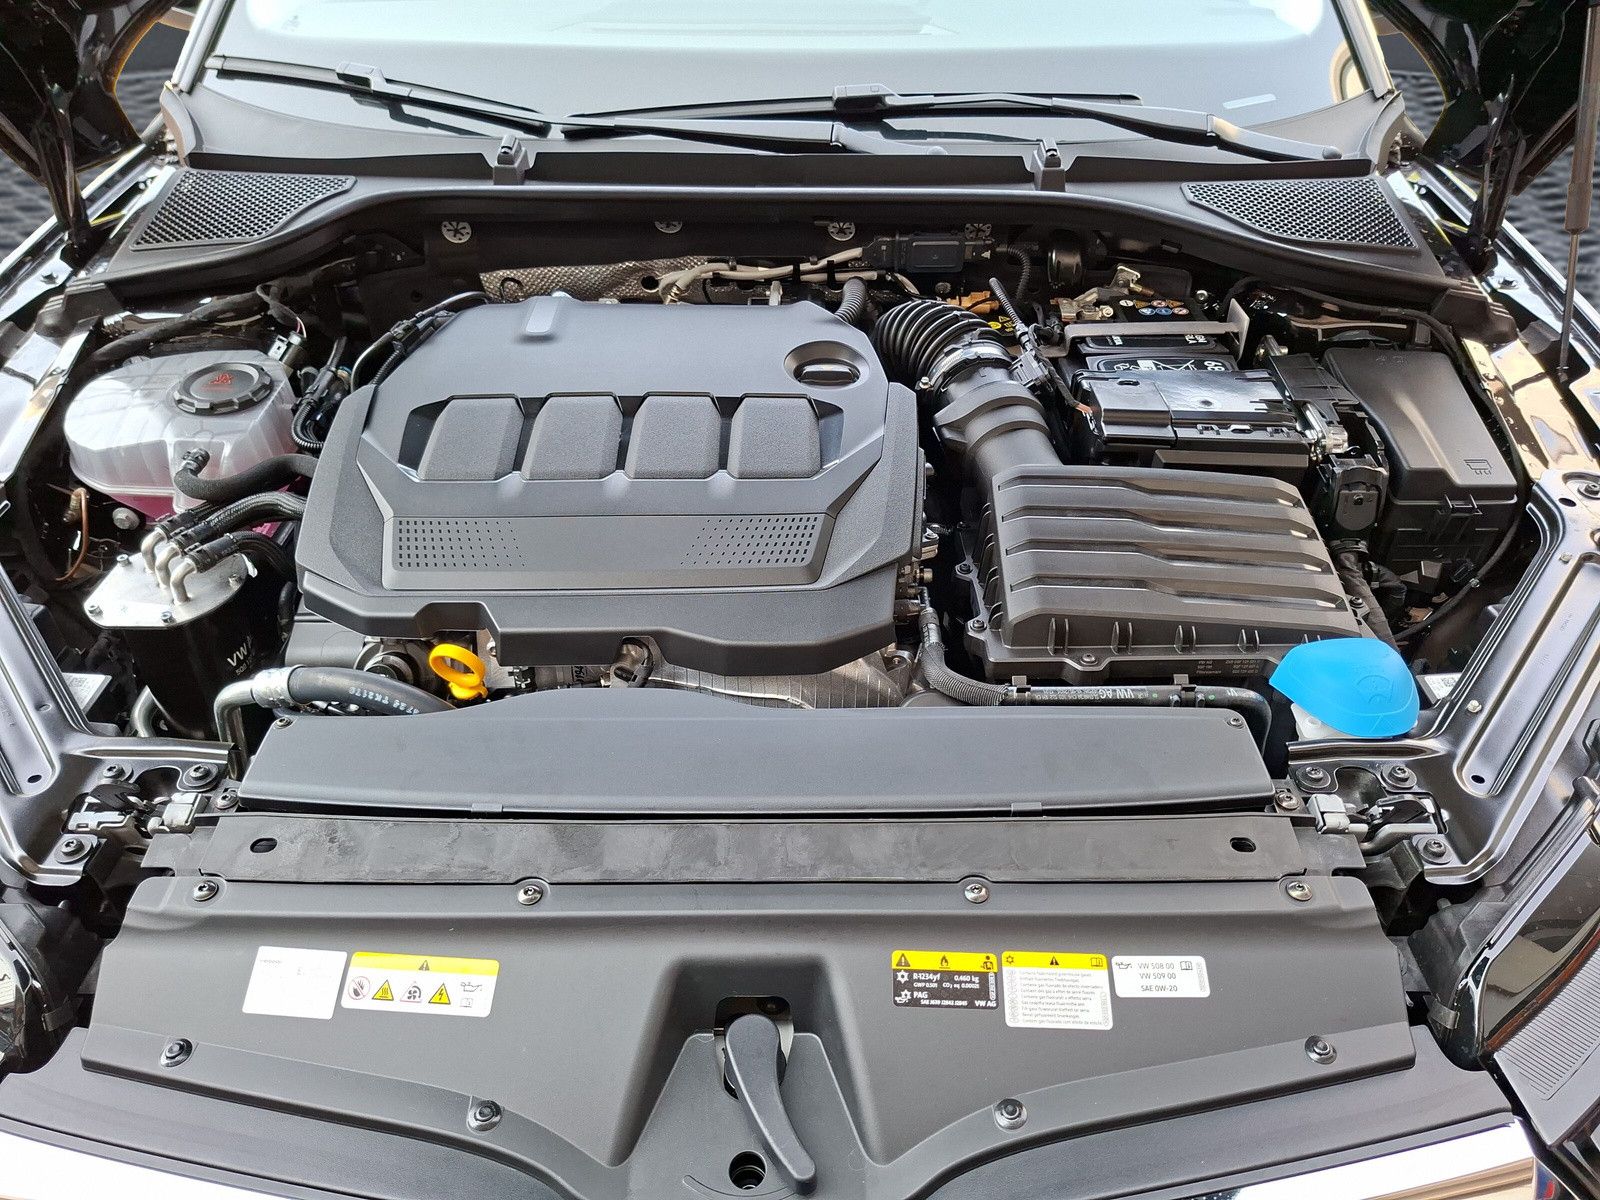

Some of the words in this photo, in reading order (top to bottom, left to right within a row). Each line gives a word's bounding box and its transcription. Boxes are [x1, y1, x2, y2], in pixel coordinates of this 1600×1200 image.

[227, 643, 247, 666] VW
[1116, 689, 1134, 699] VW
[913, 973, 941, 982] R-1234yf
[972, 975, 979, 983] kg
